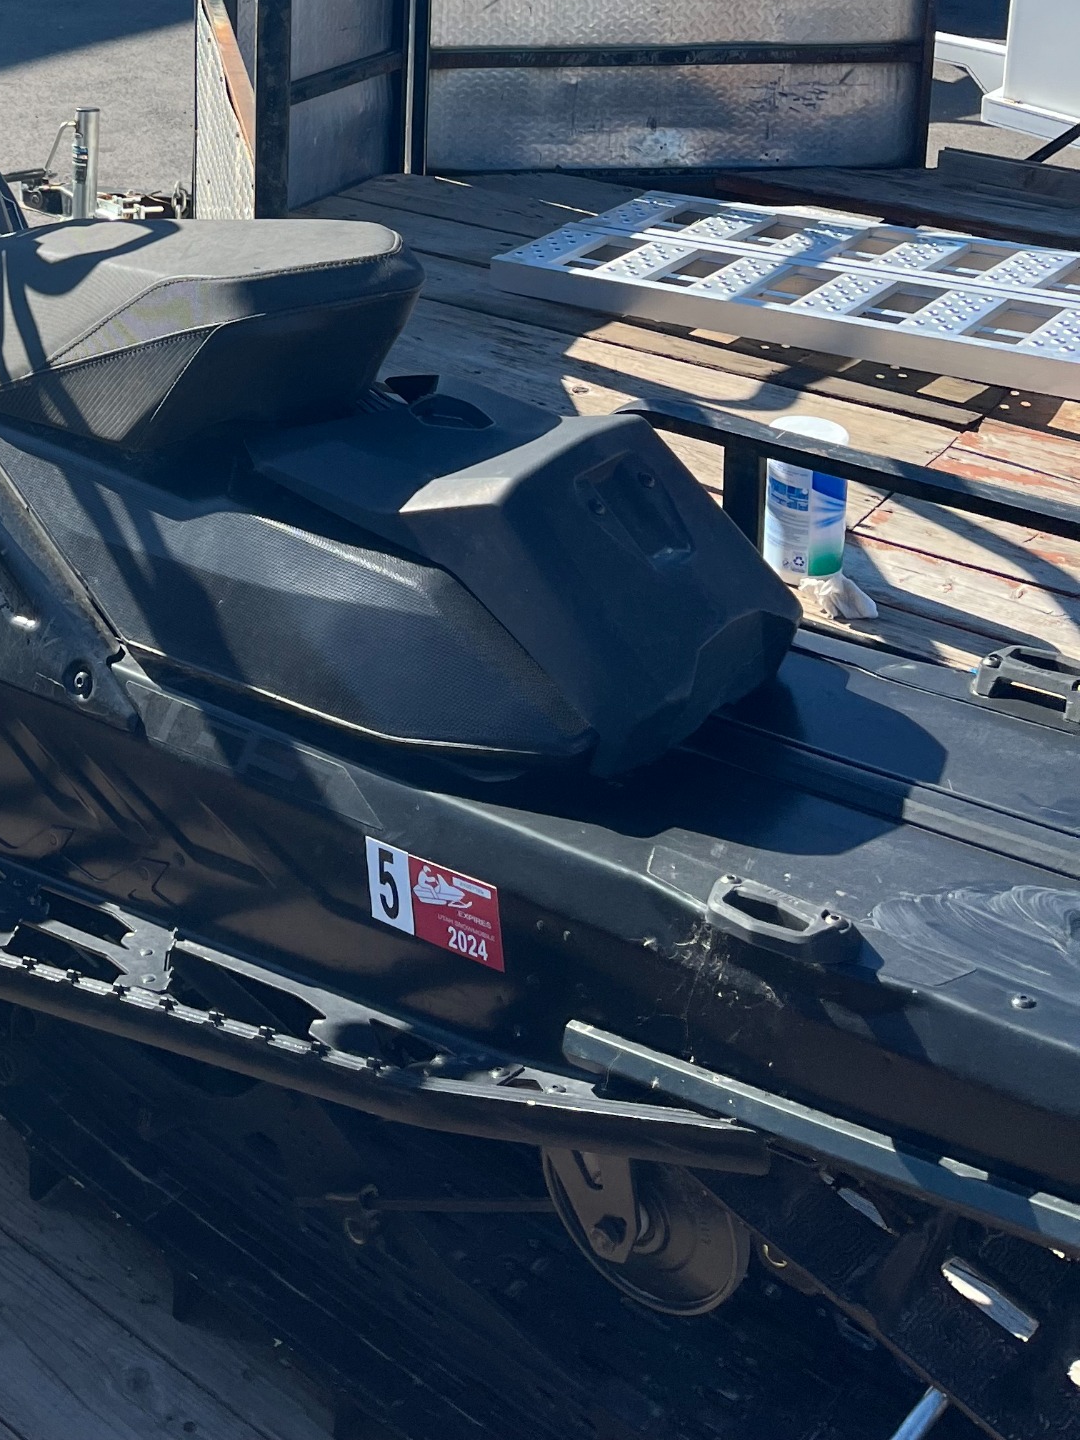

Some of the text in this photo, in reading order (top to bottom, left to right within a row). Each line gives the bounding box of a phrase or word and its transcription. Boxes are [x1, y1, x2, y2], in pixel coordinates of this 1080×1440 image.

[377, 847, 400, 920] 5
[457, 910, 492, 930] EXPIRES
[447, 925, 489, 962] 2024
